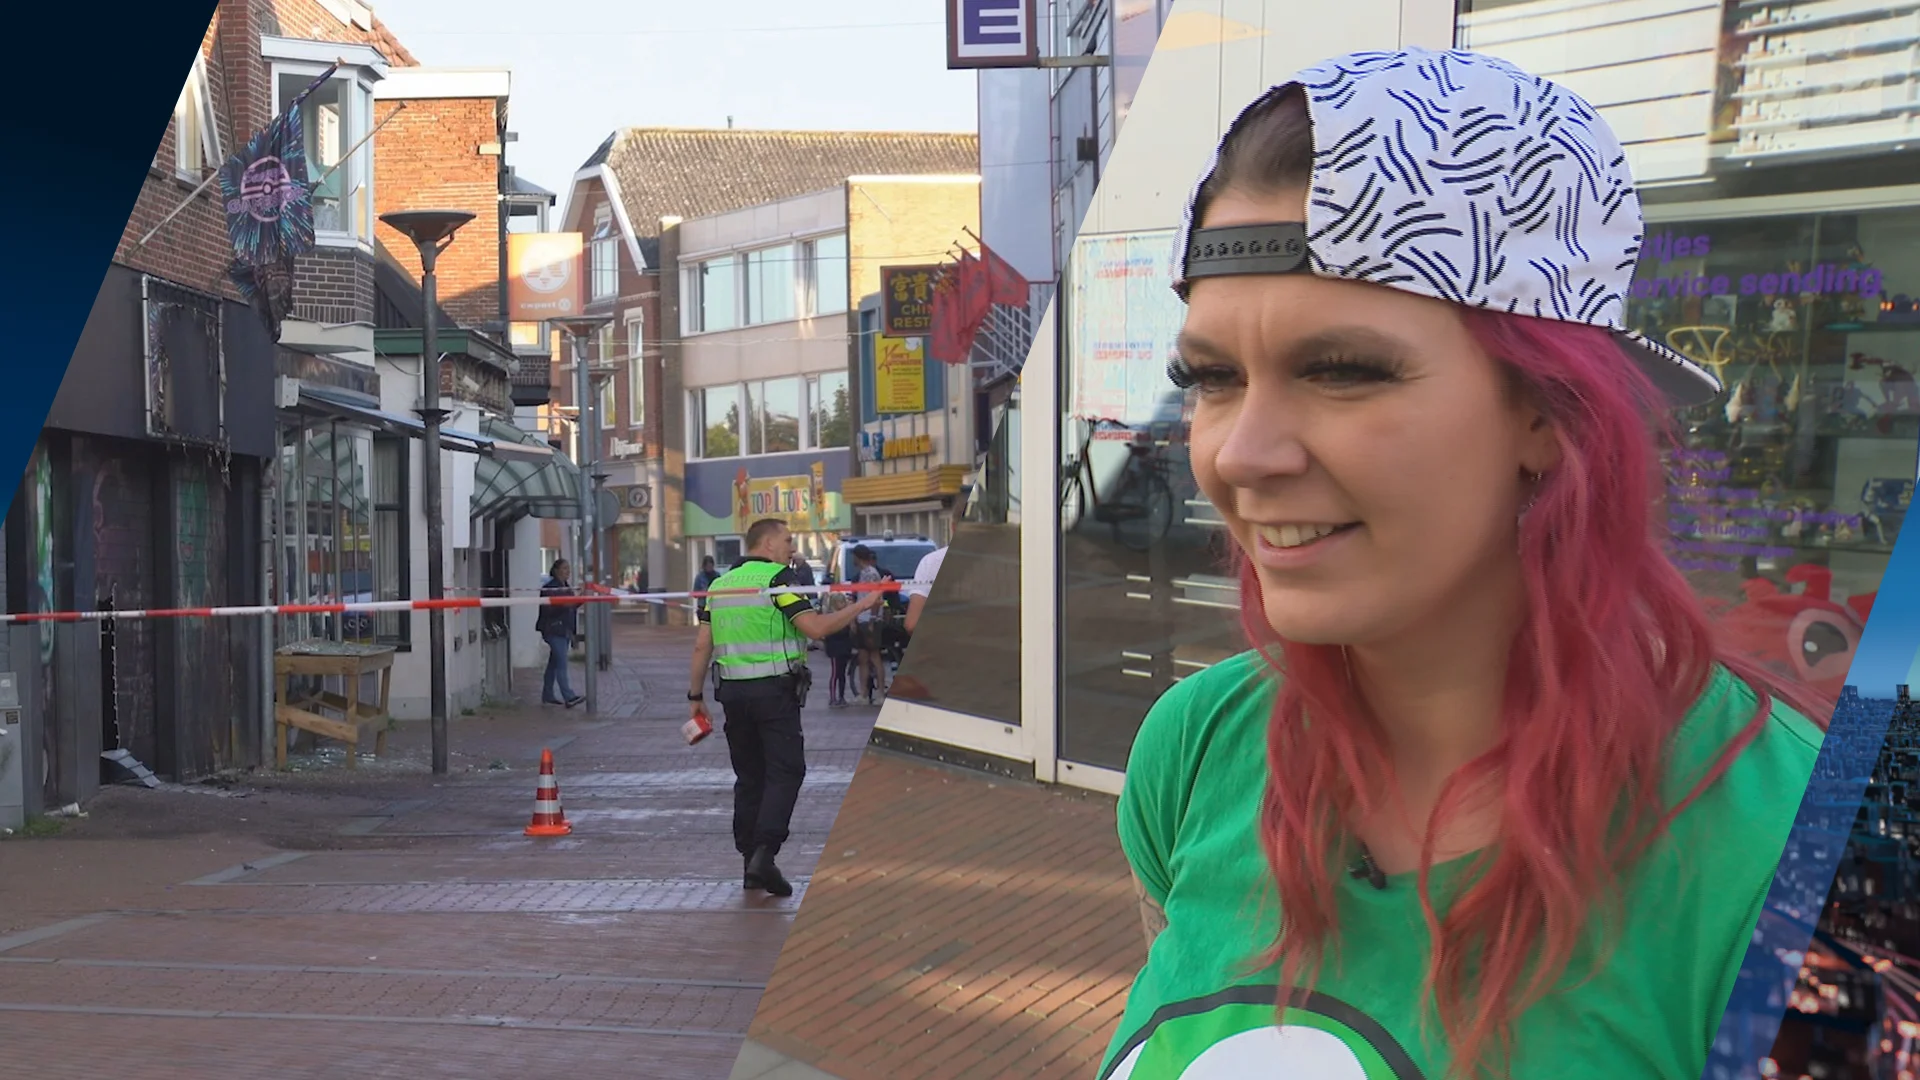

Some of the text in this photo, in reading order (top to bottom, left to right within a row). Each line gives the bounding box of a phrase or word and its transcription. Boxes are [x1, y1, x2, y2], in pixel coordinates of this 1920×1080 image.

[963, 0, 1021, 45] E
[1633, 264, 1882, 299] ervice sending
[750, 484, 809, 514] TOP 1 TOYS
